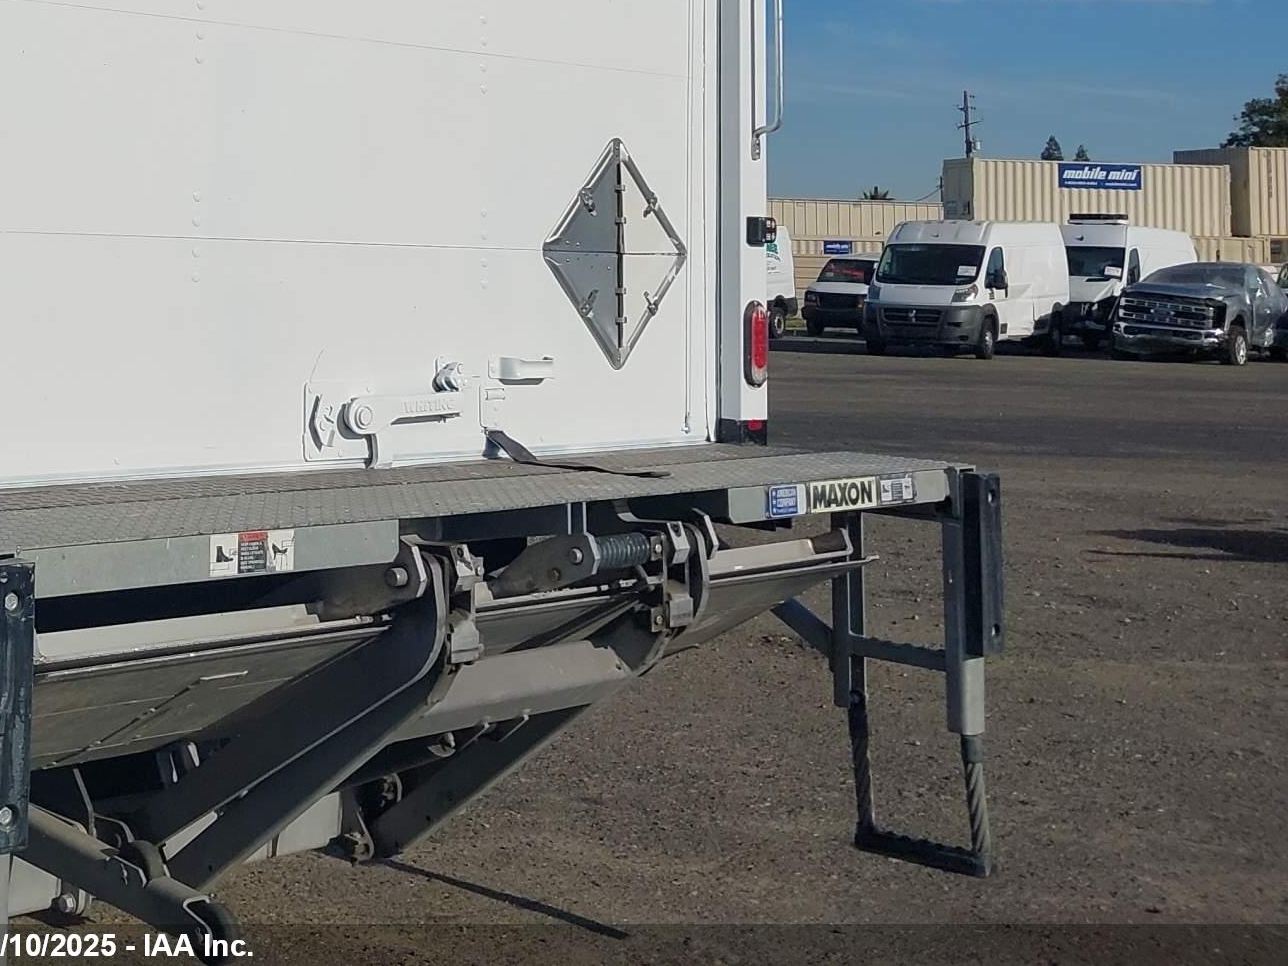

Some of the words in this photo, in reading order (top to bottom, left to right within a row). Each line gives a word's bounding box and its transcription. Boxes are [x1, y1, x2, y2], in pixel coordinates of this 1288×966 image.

[1062, 166, 1107, 180] mobile
[1107, 169, 1140, 181] mini
[813, 481, 873, 509] MAXON
